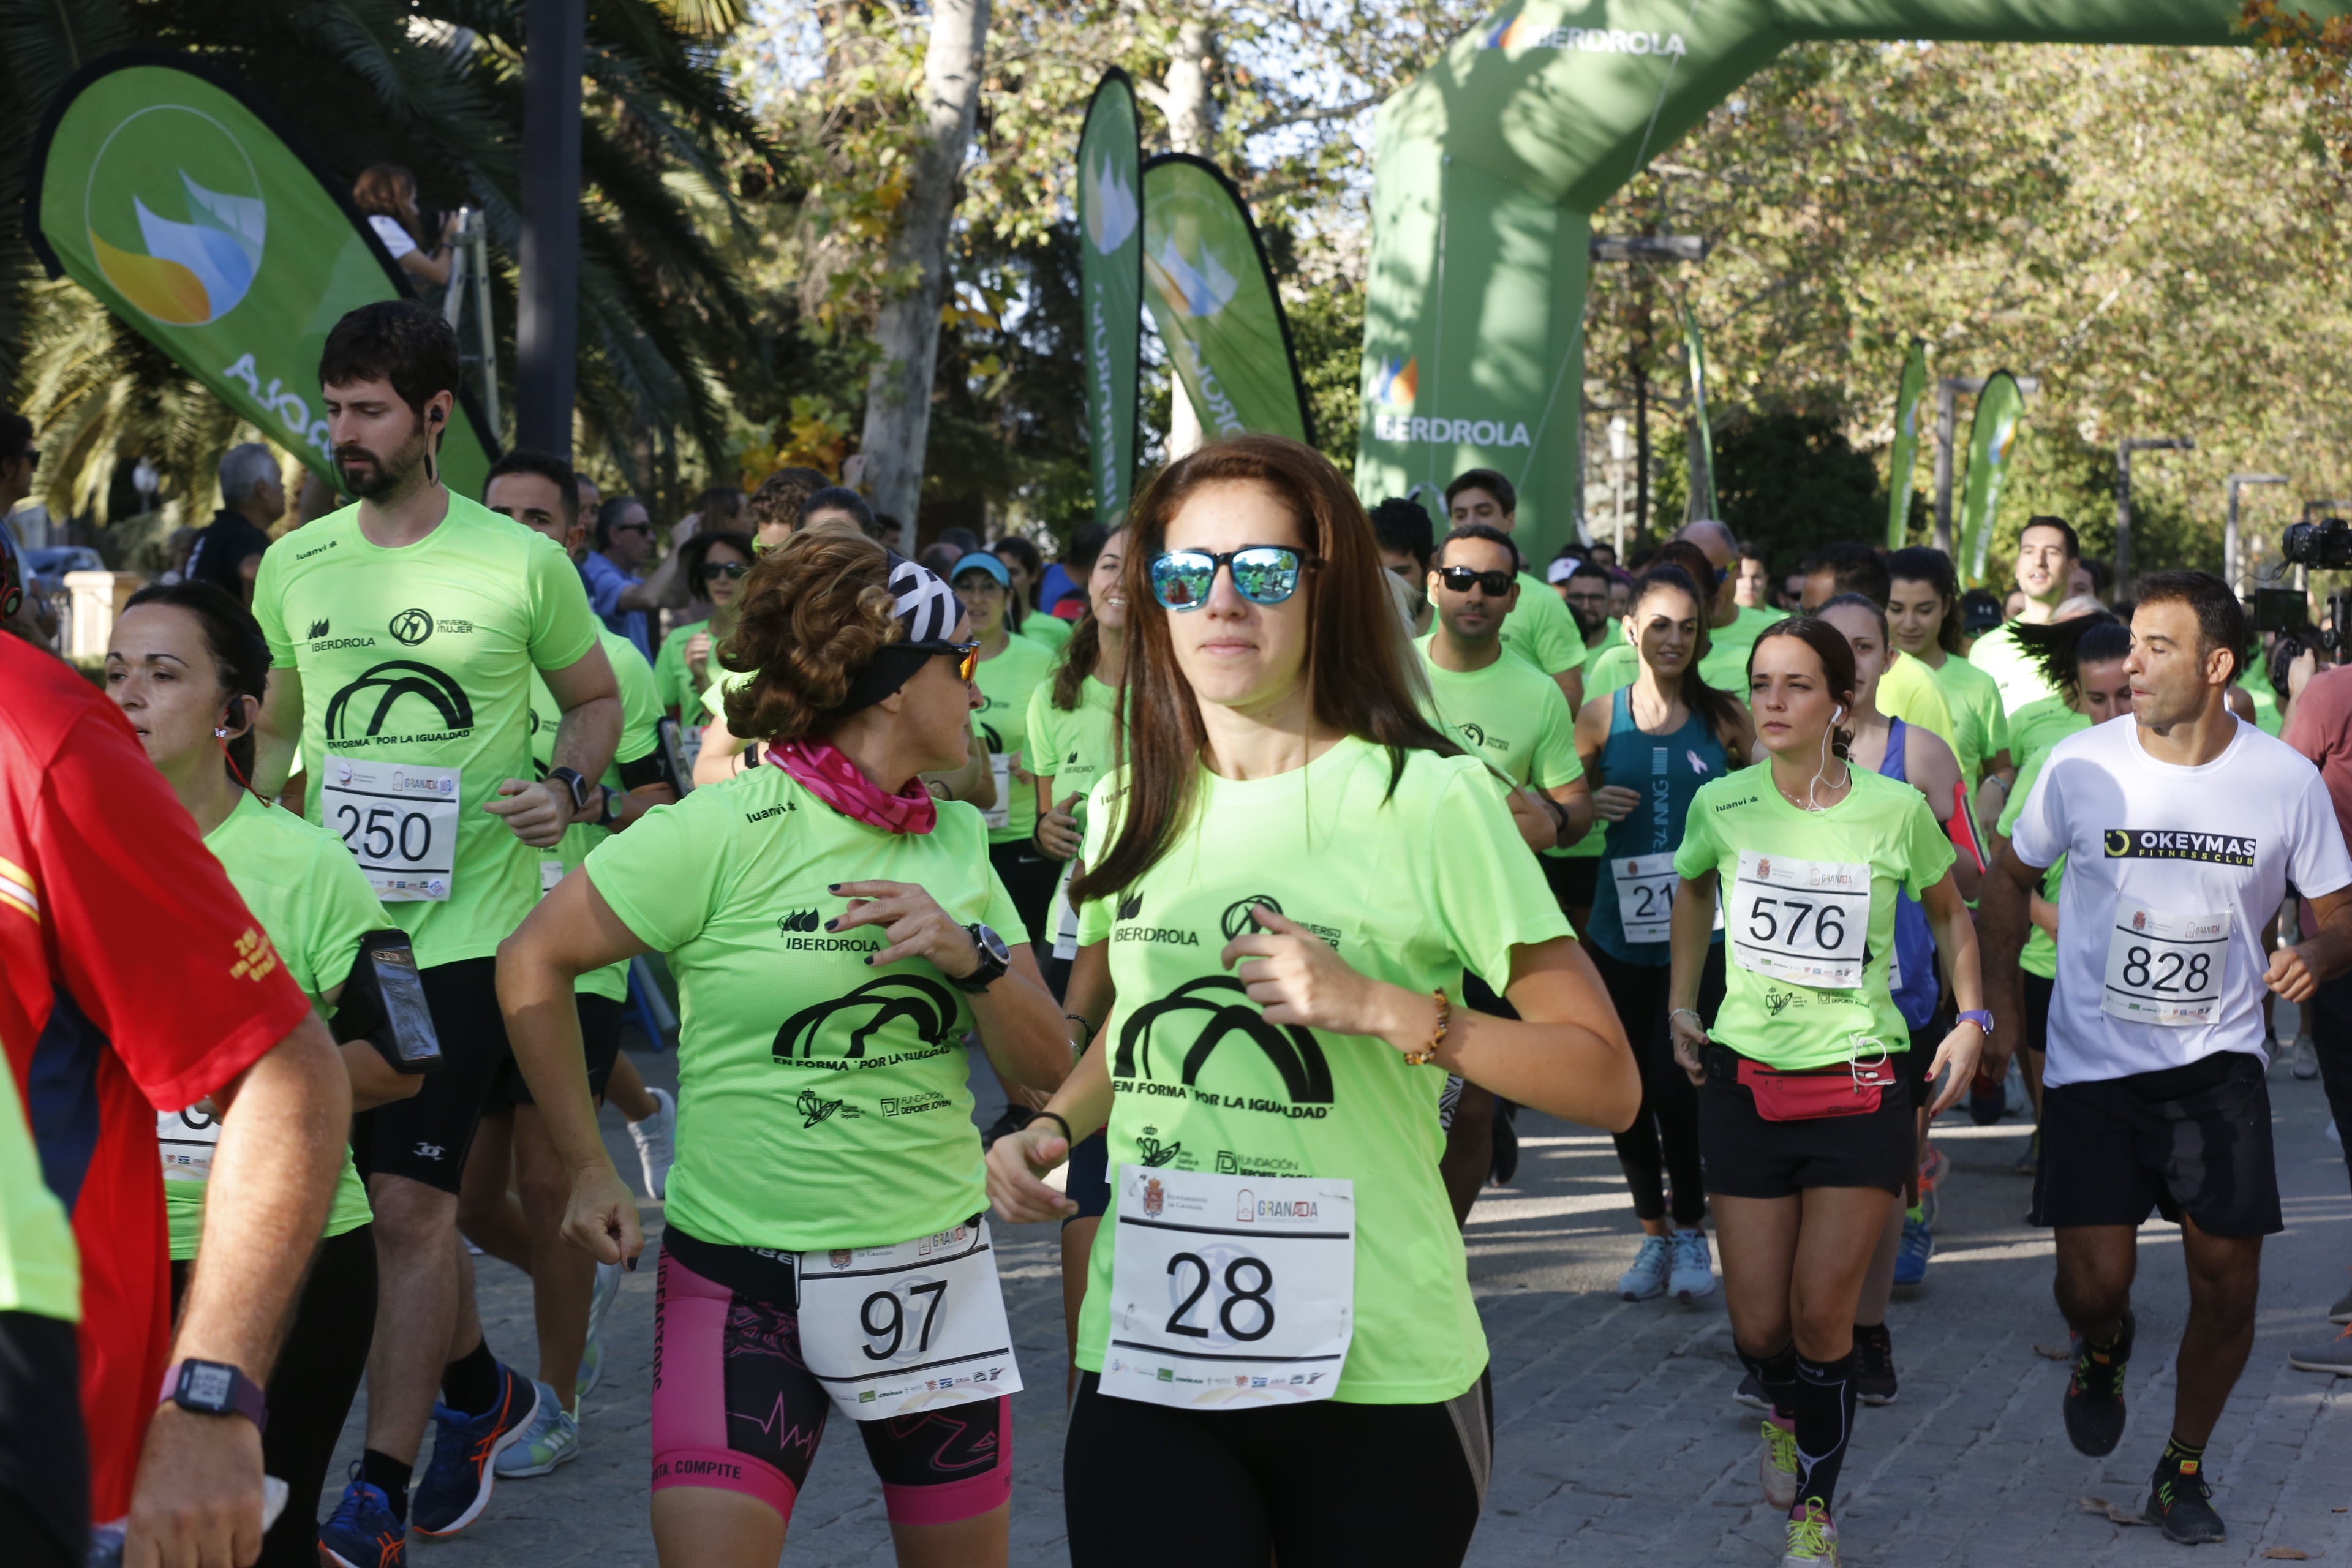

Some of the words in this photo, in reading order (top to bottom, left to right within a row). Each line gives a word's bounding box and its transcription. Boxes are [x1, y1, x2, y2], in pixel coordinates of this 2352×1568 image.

[1523, 24, 1686, 55] IBERDROLA
[1374, 414, 1531, 447] IBERDROLA
[296, 545, 326, 560] luanvi
[312, 638, 375, 652] IBERDROLA
[337, 738, 370, 748] FORMA
[400, 734, 414, 743] LA
[746, 804, 787, 823] luanvi
[1716, 798, 1746, 812] luanvi
[337, 804, 431, 862] 250
[2141, 832, 2256, 856] OKEYMAS
[2139, 849, 2207, 860] FITNESS
[2214, 853, 2253, 865] CLUB
[1292, 920, 1341, 938] NIVERSO
[1749, 896, 1845, 951] 576
[786, 938, 880, 952] IBERDROLA
[1115, 927, 1199, 946] IBERDROLA
[2123, 946, 2211, 993] 828
[796, 1060, 849, 1071] FORMA
[889, 1054, 903, 1065] LA
[1114, 1081, 1134, 1093] EN
[1137, 1082, 1187, 1099] FORMA
[1224, 1096, 1245, 1109] LA
[901, 1103, 930, 1115] DEPORTE
[1258, 1200, 1317, 1217] GRANADA
[932, 1226, 968, 1248] GRANADA
[1166, 1252, 1275, 1341] 28
[861, 1279, 948, 1360] 97
[676, 1460, 742, 1480] COMPITE
